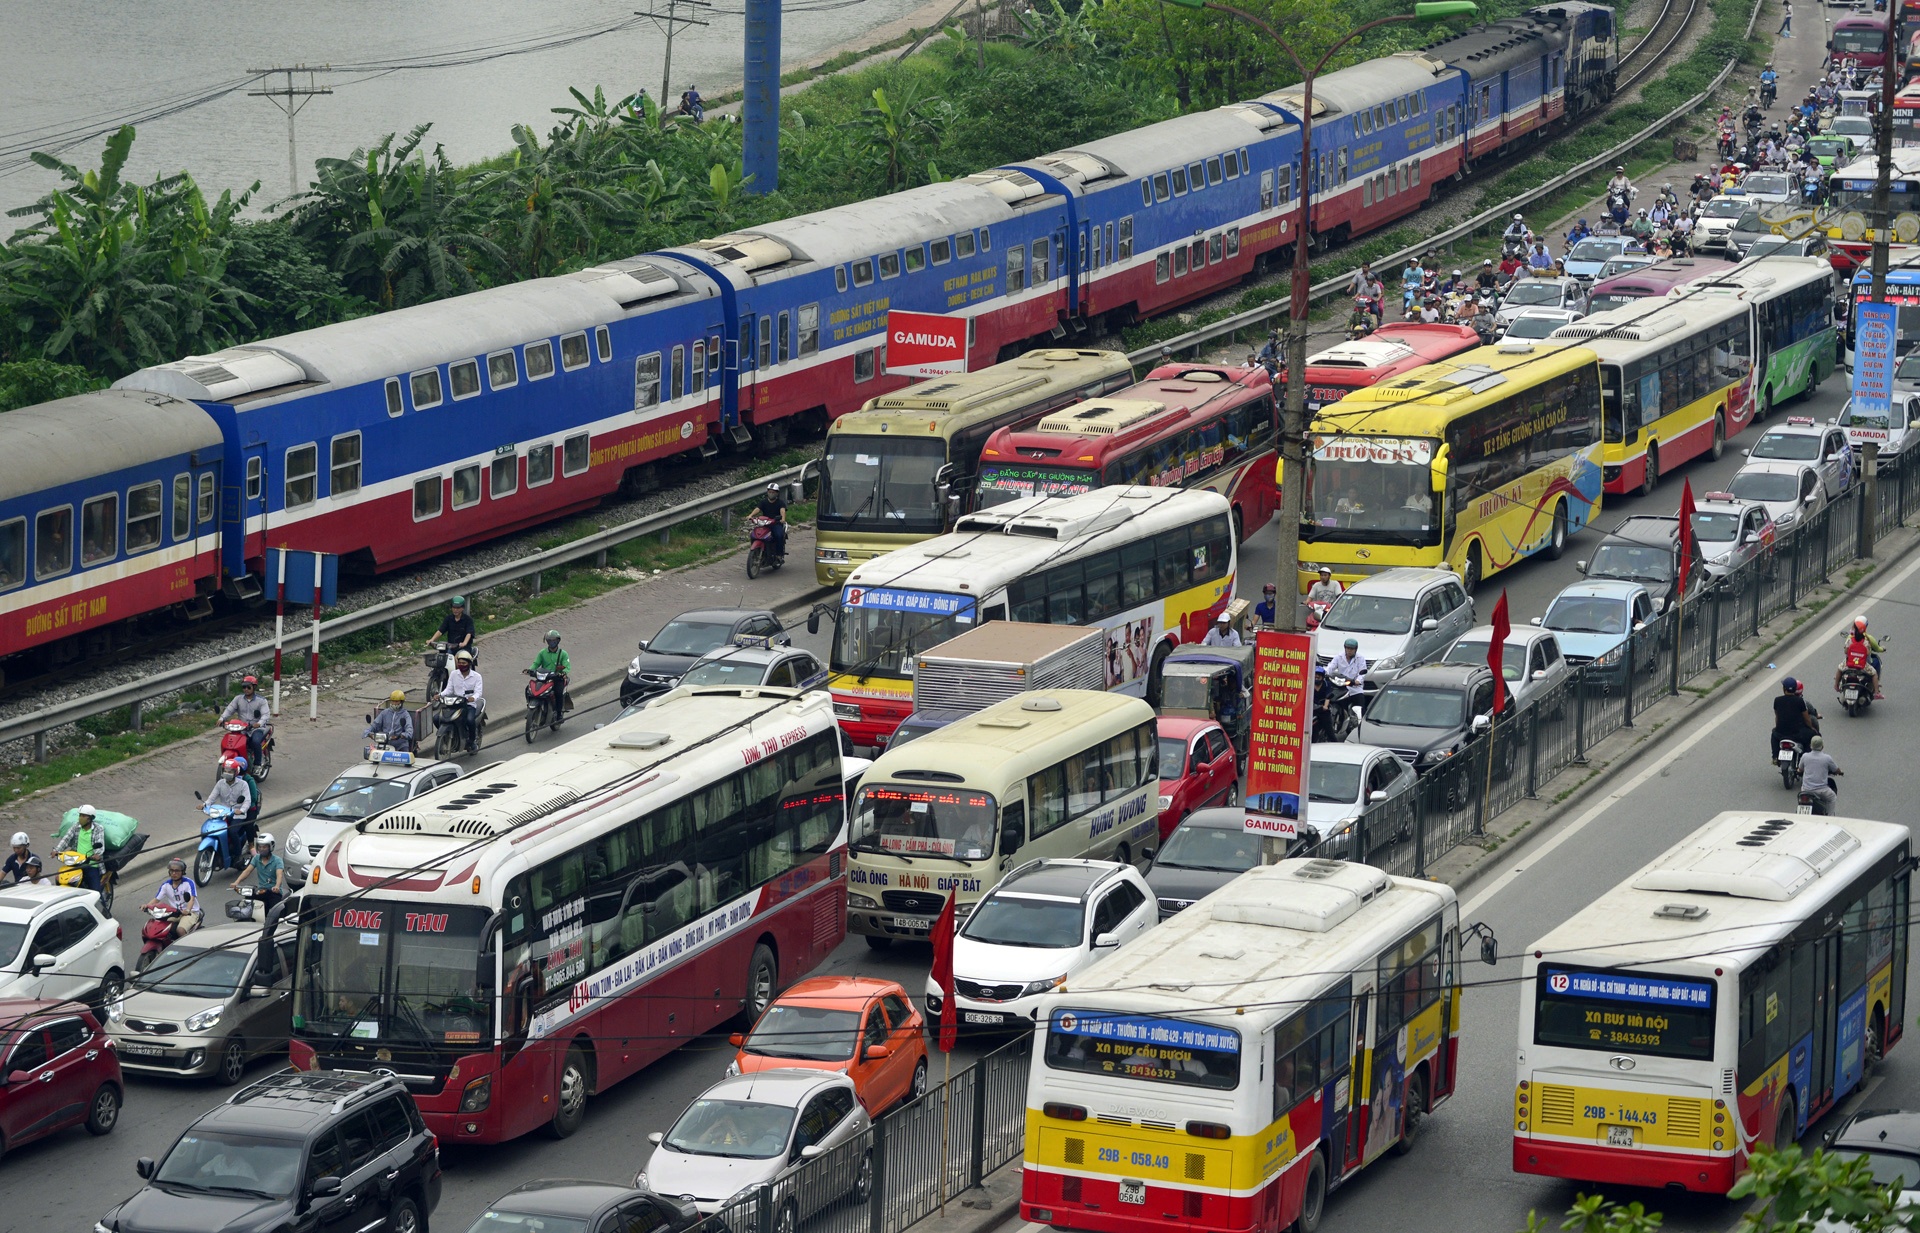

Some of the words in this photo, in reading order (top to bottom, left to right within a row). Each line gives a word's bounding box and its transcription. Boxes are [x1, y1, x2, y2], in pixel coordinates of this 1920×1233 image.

[876, 297, 890, 311] NAM
[894, 331, 956, 348] GAMUDA
[1545, 412, 1557, 428] CAO
[1850, 430, 1886, 438] GAMUDA
[1200, 451, 1212, 470] Cao
[850, 589, 862, 604] 8
[866, 591, 879, 605] LONG
[880, 593, 892, 605] BIÊN
[896, 597, 904, 607] BX
[906, 594, 918, 608] GIÁP
[919, 596, 930, 608] BÁT
[72, 599, 88, 625] VIỆT
[90, 596, 107, 618] NAM
[1259, 646, 1284, 658] NGHIÊM
[1286, 648, 1306, 660] CHỈNH
[1263, 660, 1280, 672] CHẤP
[1282, 663, 1300, 674] HÀNH
[1258, 674, 1271, 686] CÁC
[1272, 677, 1286, 687] QUY
[1287, 679, 1303, 690] ĐỊNH
[1271, 691, 1287, 703] TRẬT
[1289, 694, 1298, 704] TỰ
[1264, 705, 1273, 715] AN
[1275, 706, 1292, 716] TOÀN
[1258, 719, 1274, 728] GIAO
[1275, 720, 1296, 732] THÔNG
[741, 746, 761, 765] LONG
[761, 737, 778, 755] THU
[779, 726, 807, 747] EXPRESS
[1253, 732, 1268, 744] TRẬT
[1270, 734, 1279, 745] TỰ
[1290, 737, 1300, 748] THỊ
[1258, 746, 1266, 757] VÀ
[1268, 748, 1276, 760] VỆ
[1277, 750, 1293, 760] SINH
[1253, 760, 1266, 771] MÔI
[1268, 763, 1296, 775] TRƯỜNG!
[1245, 819, 1295, 833] GAMUDA
[889, 840, 902, 850] LONG
[849, 866, 866, 883] CỬA
[868, 870, 887, 885] ÔNG
[898, 872, 910, 888] HÀ
[912, 874, 928, 891] NỘI
[937, 876, 958, 890] GIÁP
[961, 876, 980, 892] BÁT
[333, 908, 384, 929] LONG
[406, 913, 449, 932] THU
[568, 938, 583, 959] THU
[600, 975, 612, 995] TUM
[615, 972, 623, 987] GIA
[624, 965, 632, 983] LAI
[1553, 976, 1567, 988] 12
[1604, 1013, 1624, 1025] BUS
[1627, 1013, 1643, 1028] HÀ
[1646, 1016, 1668, 1032] NỘI
[1610, 1031, 1660, 1045] 38436393
[1114, 1044, 1134, 1056] BUS
[1124, 1065, 1176, 1079] 38436393
[1108, 1104, 1167, 1120] DAEWOO
[1584, 1105, 1606, 1119] 29B
[1618, 1109, 1656, 1124] 144.43
[1609, 1136, 1632, 1146] 144.43
[1098, 1148, 1119, 1162] 29B
[1131, 1152, 1169, 1169] 058.49
[1125, 1184, 1139, 1194] 29B
[1119, 1192, 1144, 1204] 058.49
